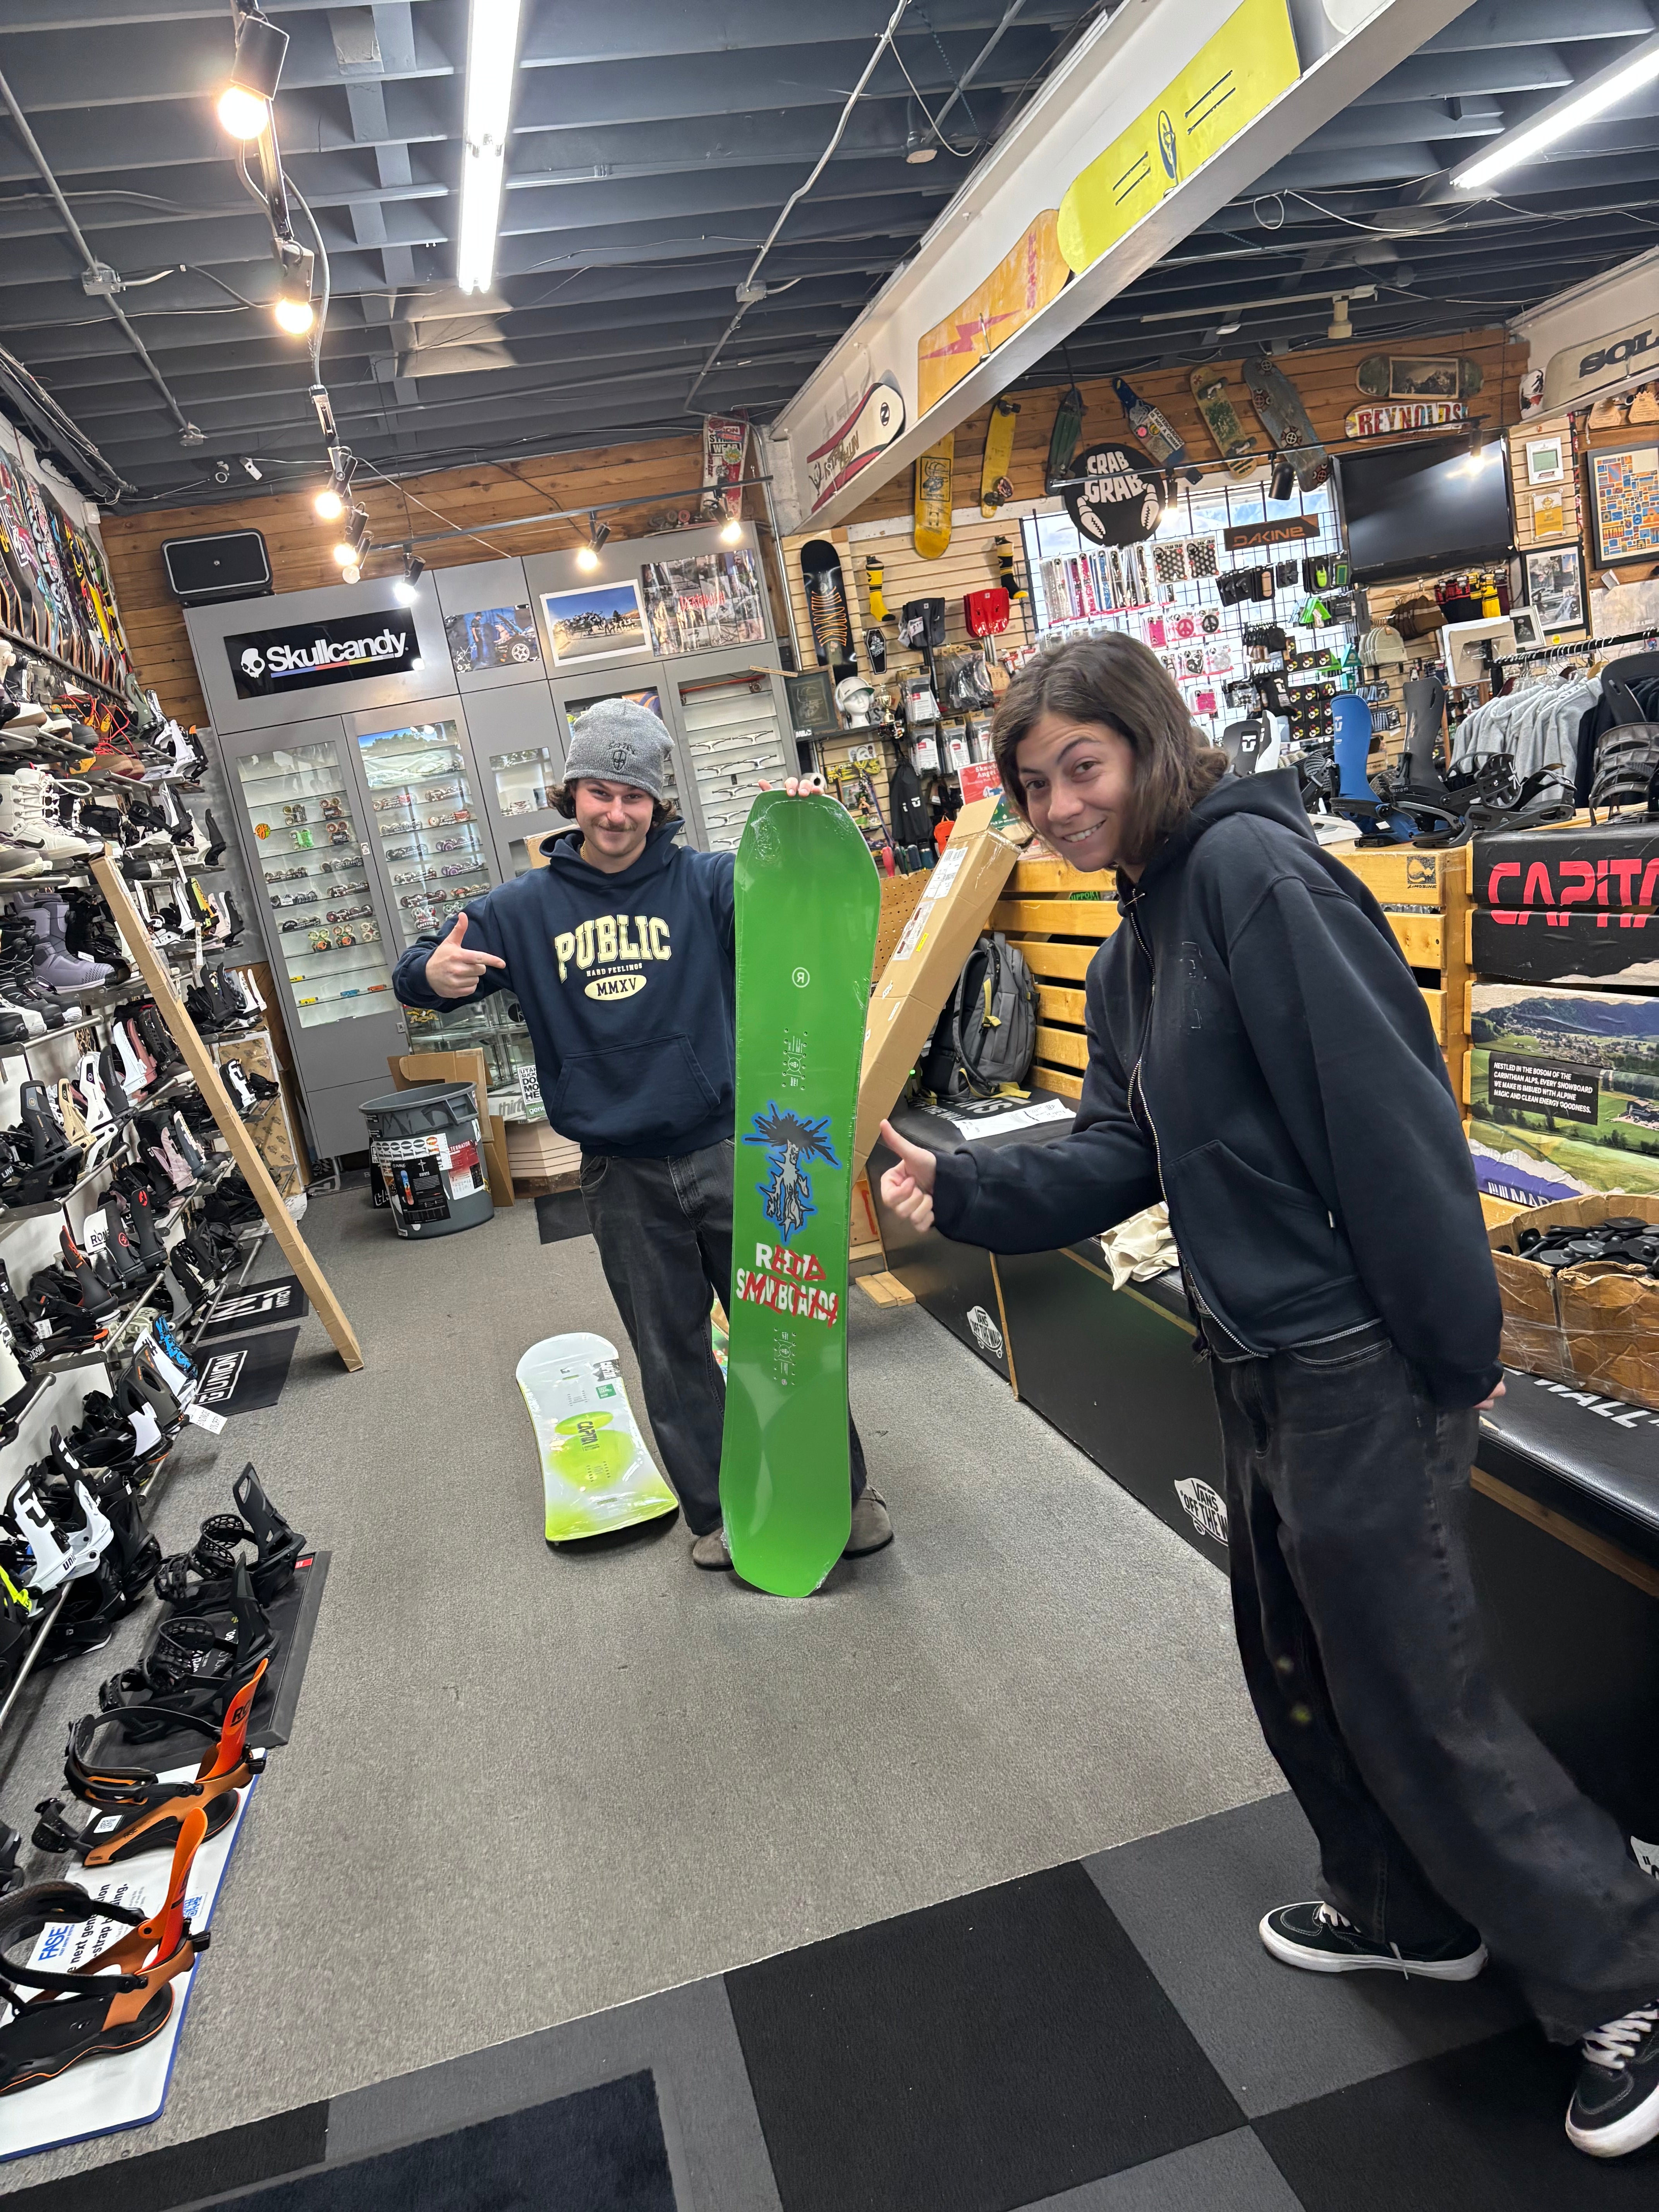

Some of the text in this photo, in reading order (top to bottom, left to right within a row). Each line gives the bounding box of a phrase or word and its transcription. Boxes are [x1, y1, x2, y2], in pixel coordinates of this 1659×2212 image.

[1579, 329, 1659, 378] SOL
[1154, 409, 1184, 445] SKATEBOARDING
[1357, 404, 1462, 436] REYNOLDS
[1154, 418, 1163, 428] NOT
[1166, 433, 1180, 448] CRIME
[1087, 451, 1129, 474] CRAB
[1085, 468, 1144, 503] GRAB
[1233, 526, 1306, 548] DAKINE
[1603, 526, 1624, 539] UTAH
[267, 629, 406, 672] Skullcandy
[554, 914, 672, 984] PUBLIC
[586, 963, 642, 977] HARD FEELINGS
[596, 977, 637, 996] MMXV
[1494, 1062, 1516, 1071] NESTLED
[1533, 1068, 1551, 1077] BOSOM
[1561, 1072, 1571, 1080] THE
[1494, 1071, 1524, 1082] CARINTHIAN
[1540, 1079, 1557, 1087] EVERY
[1558, 1082, 1593, 1094] SNOWBOARD
[1494, 1089, 1592, 1114] MAGIC AND CLEAN ENERGY GOODNESS.
[1502, 1082, 1517, 1090] MAKE
[1522, 1085, 1542, 1094] IMBUED
[1542, 1088, 1556, 1097] WITH
[1556, 1091, 1577, 1101] ALPINE
[449, 1140, 471, 1153] LTERNATOR
[974, 1307, 989, 1327] VANS
[204, 1354, 239, 1392] UNION
[1191, 1480, 1219, 1512] VANS
[1199, 1503, 1221, 1537] THE
[62, 1554, 76, 1571] UNI
[38, 1925, 69, 1961] FASE
[70, 1939, 89, 1964] next
